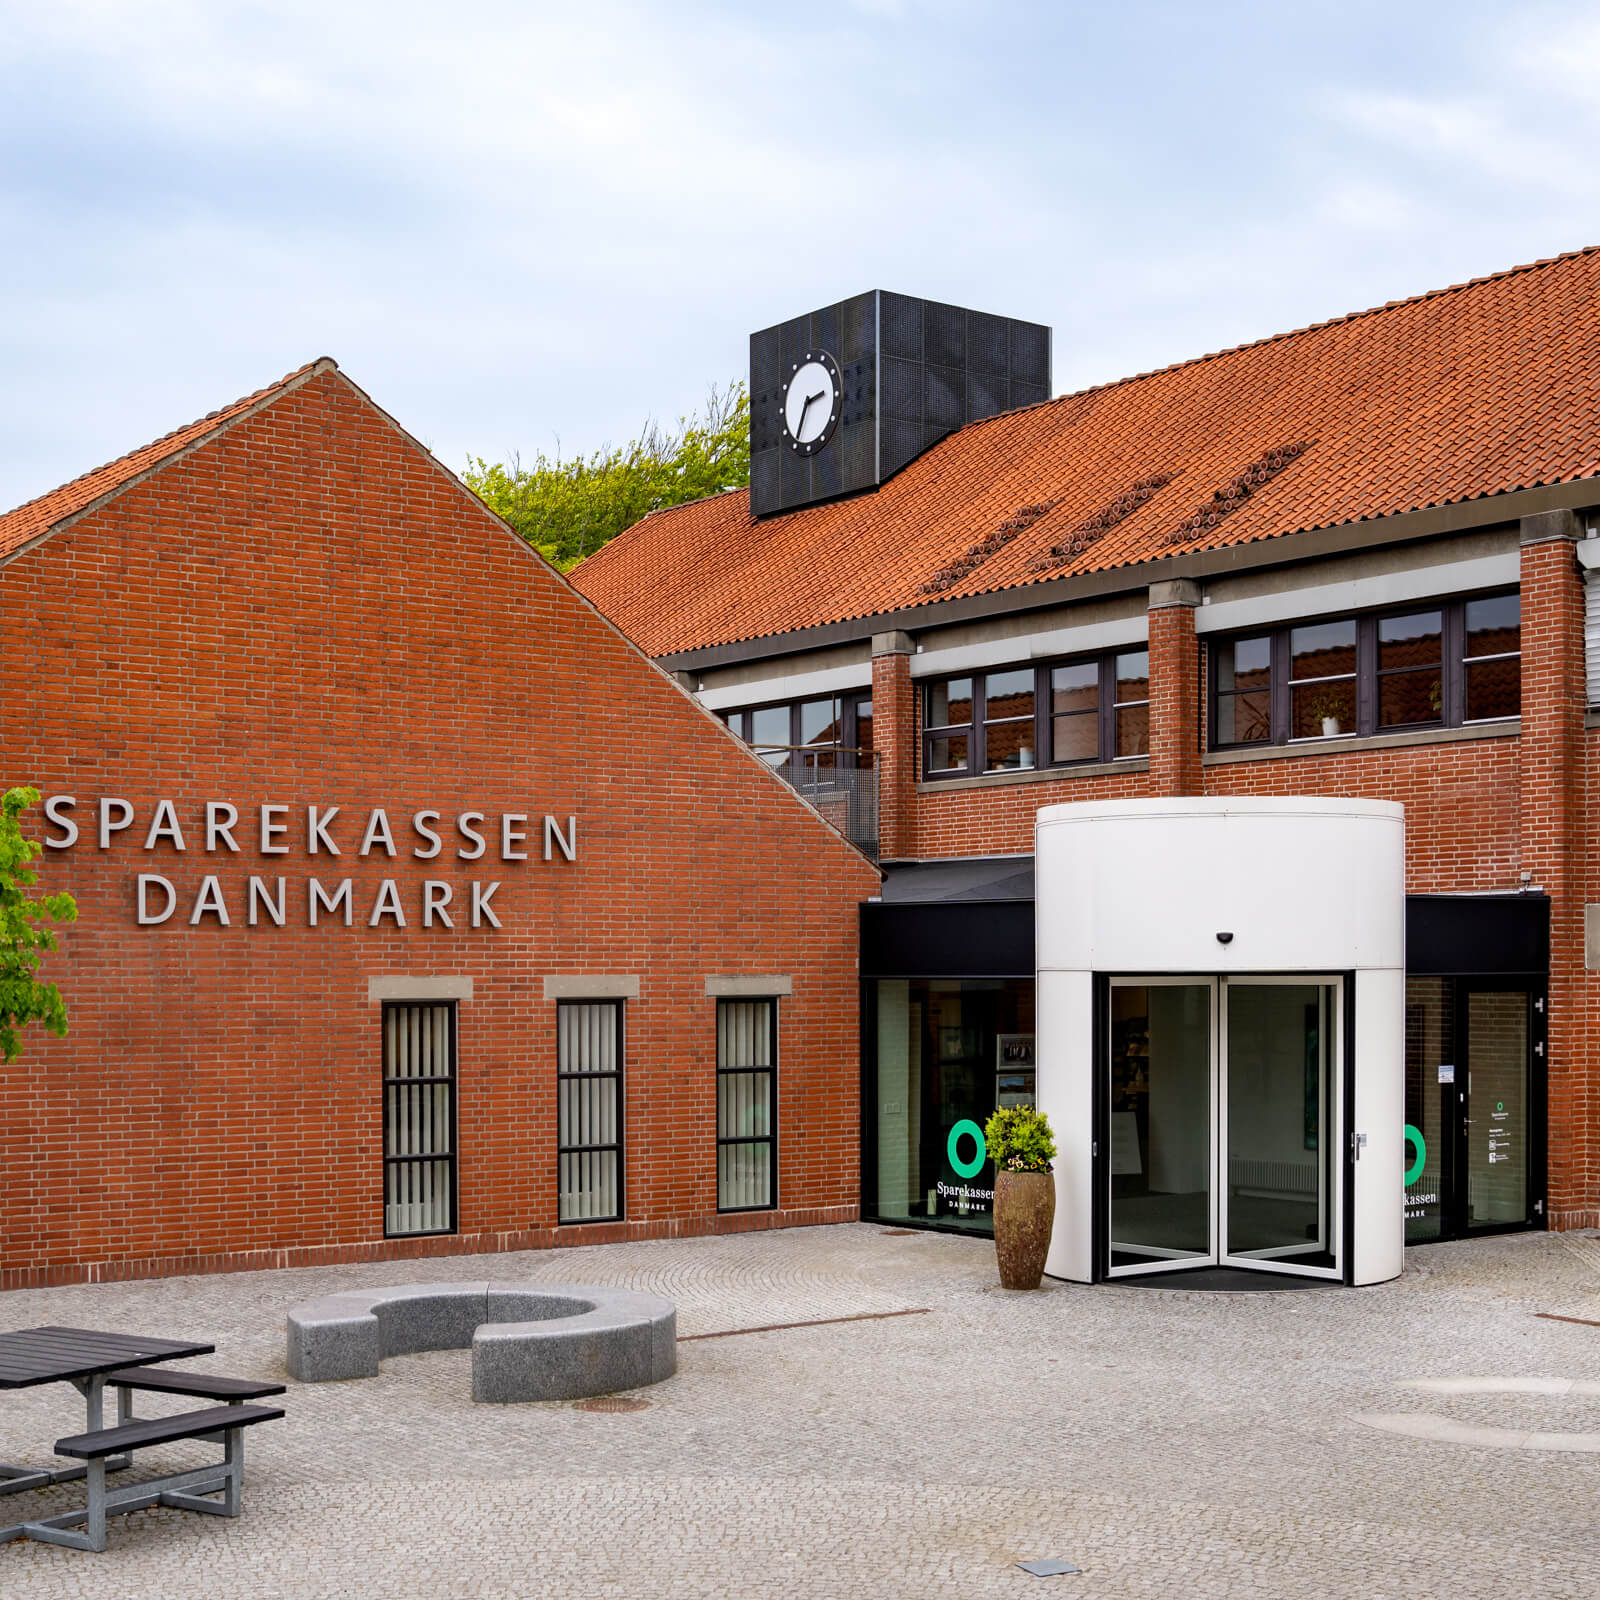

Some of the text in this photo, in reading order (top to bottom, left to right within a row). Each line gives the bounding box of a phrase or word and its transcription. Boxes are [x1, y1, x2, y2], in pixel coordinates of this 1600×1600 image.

[43, 795, 577, 862] SPAREKASSEN
[136, 873, 503, 929] DANMARK
[948, 1200, 986, 1211] DANMARK
